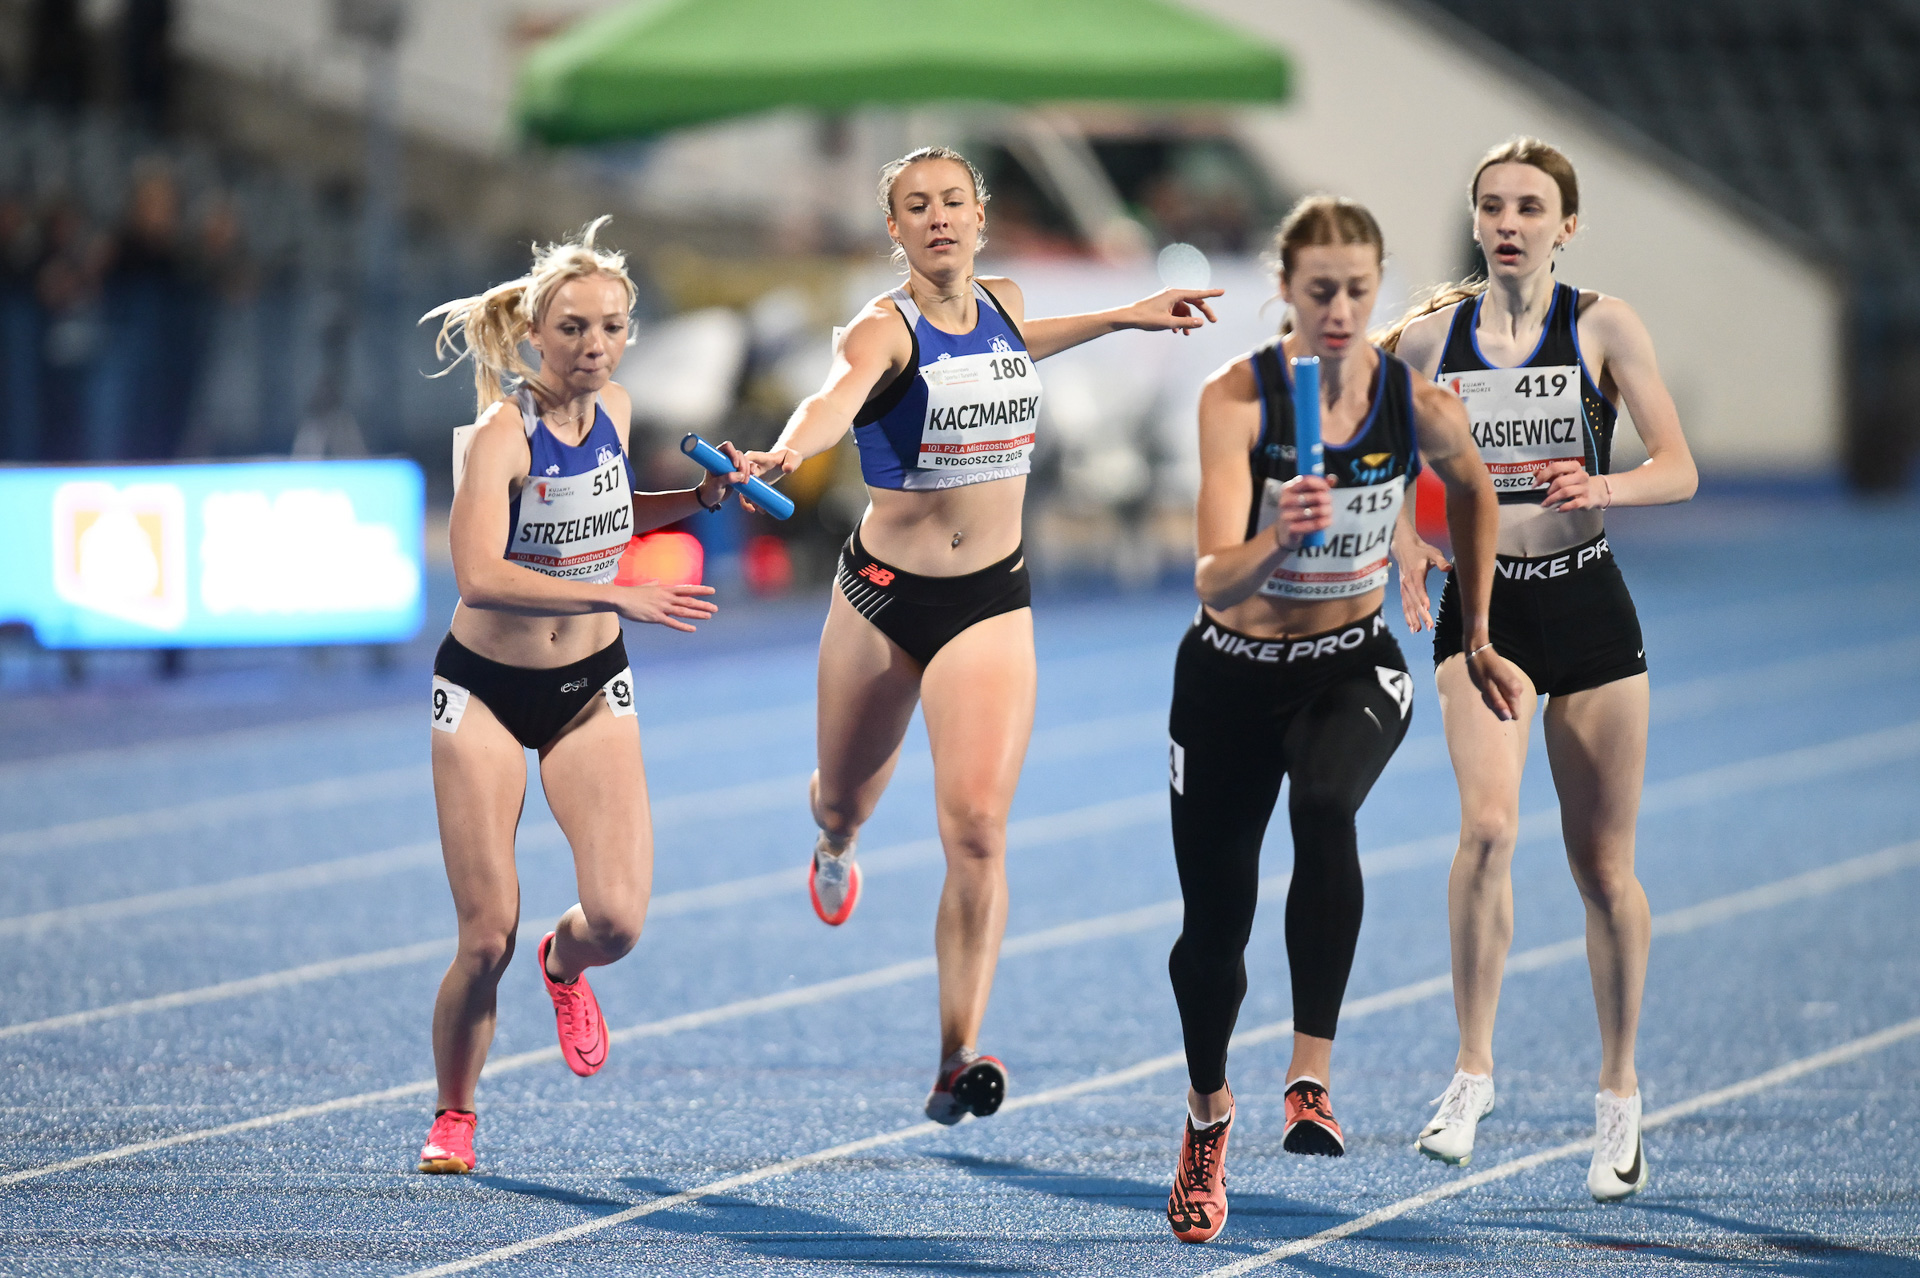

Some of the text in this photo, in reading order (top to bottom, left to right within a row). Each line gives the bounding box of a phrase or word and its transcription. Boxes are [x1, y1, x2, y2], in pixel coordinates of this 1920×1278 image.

[989, 357, 1027, 381] 180
[1515, 374, 1567, 398] 419
[929, 396, 1038, 430] KACZMAREK
[927, 435, 1030, 454] 101. PZLA Mistrzostwa Polski
[1471, 417, 1576, 448] KASIEWICZ
[935, 450, 1022, 466] BYDGOSZCZ 2025
[1491, 462, 1546, 473] Mistrzostwa
[592, 465, 620, 496] 517
[936, 464, 1020, 489] AZS POZNAŃ
[1494, 477, 1535, 487] OSZCZ
[1346, 488, 1393, 515] 415
[520, 505, 629, 545] STRZELEWICZ
[534, 555, 555, 566] PZLA
[557, 552, 604, 566] Mistrzostwa
[605, 544, 625, 557] Polski
[594, 558, 615, 572] 2025
[1495, 537, 1609, 580] NIKE PR
[1267, 577, 1374, 594] BYDGOSZCZ 2025
[1202, 624, 1365, 663] NIKE PRO
[612, 679, 631, 707] 9
